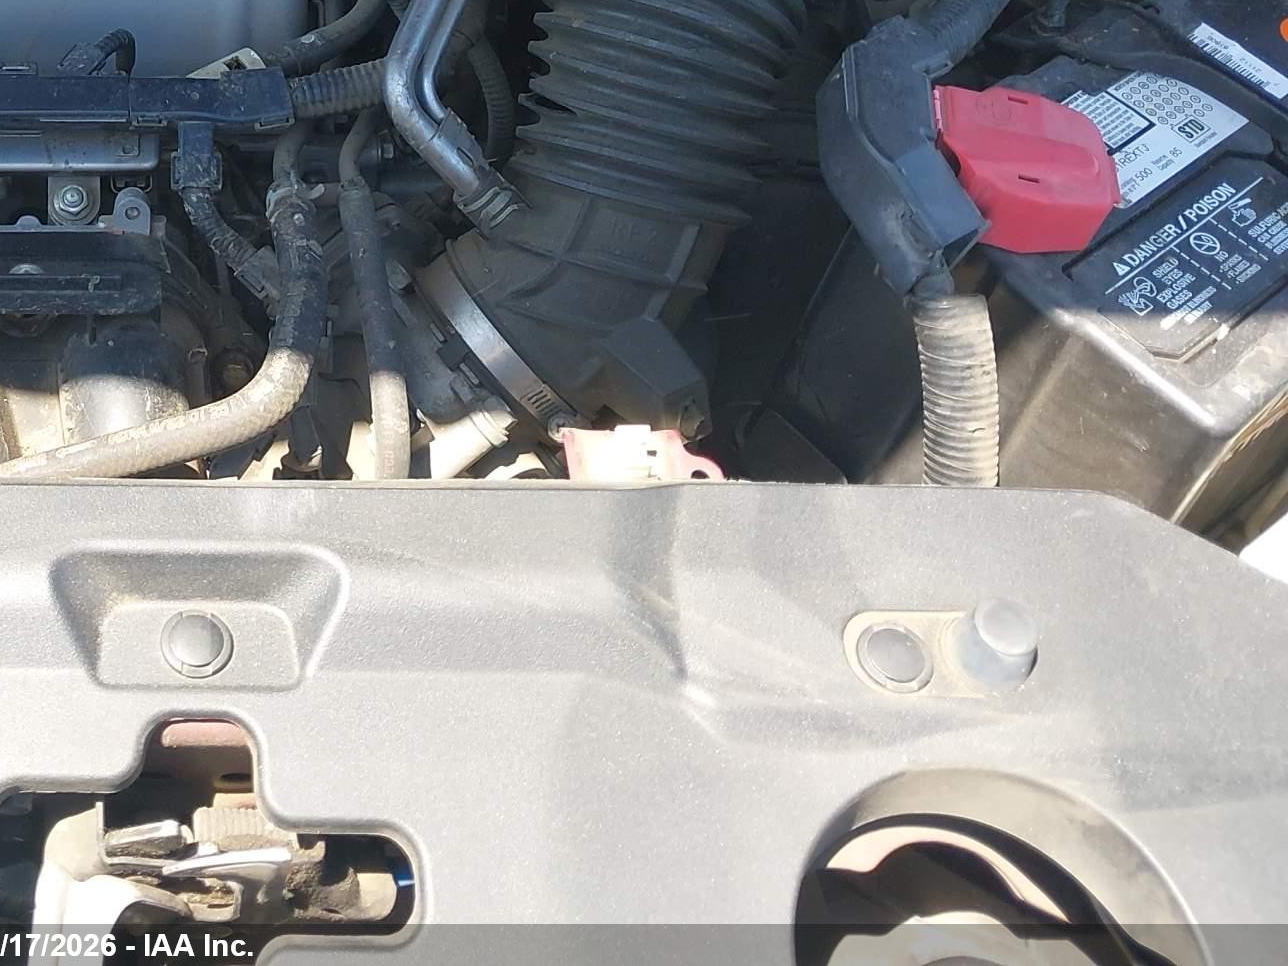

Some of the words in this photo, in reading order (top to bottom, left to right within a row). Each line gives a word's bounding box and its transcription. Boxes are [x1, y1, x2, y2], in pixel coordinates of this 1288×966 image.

[1177, 118, 1205, 139] STD
[1135, 167, 1153, 184] 500
[1214, 250, 1229, 263] NO
[1152, 257, 1180, 279] SHIELD
[1162, 268, 1184, 286] EYES
[1156, 273, 1197, 304] EXPLOSIVE
[1166, 289, 1193, 310] GASES
